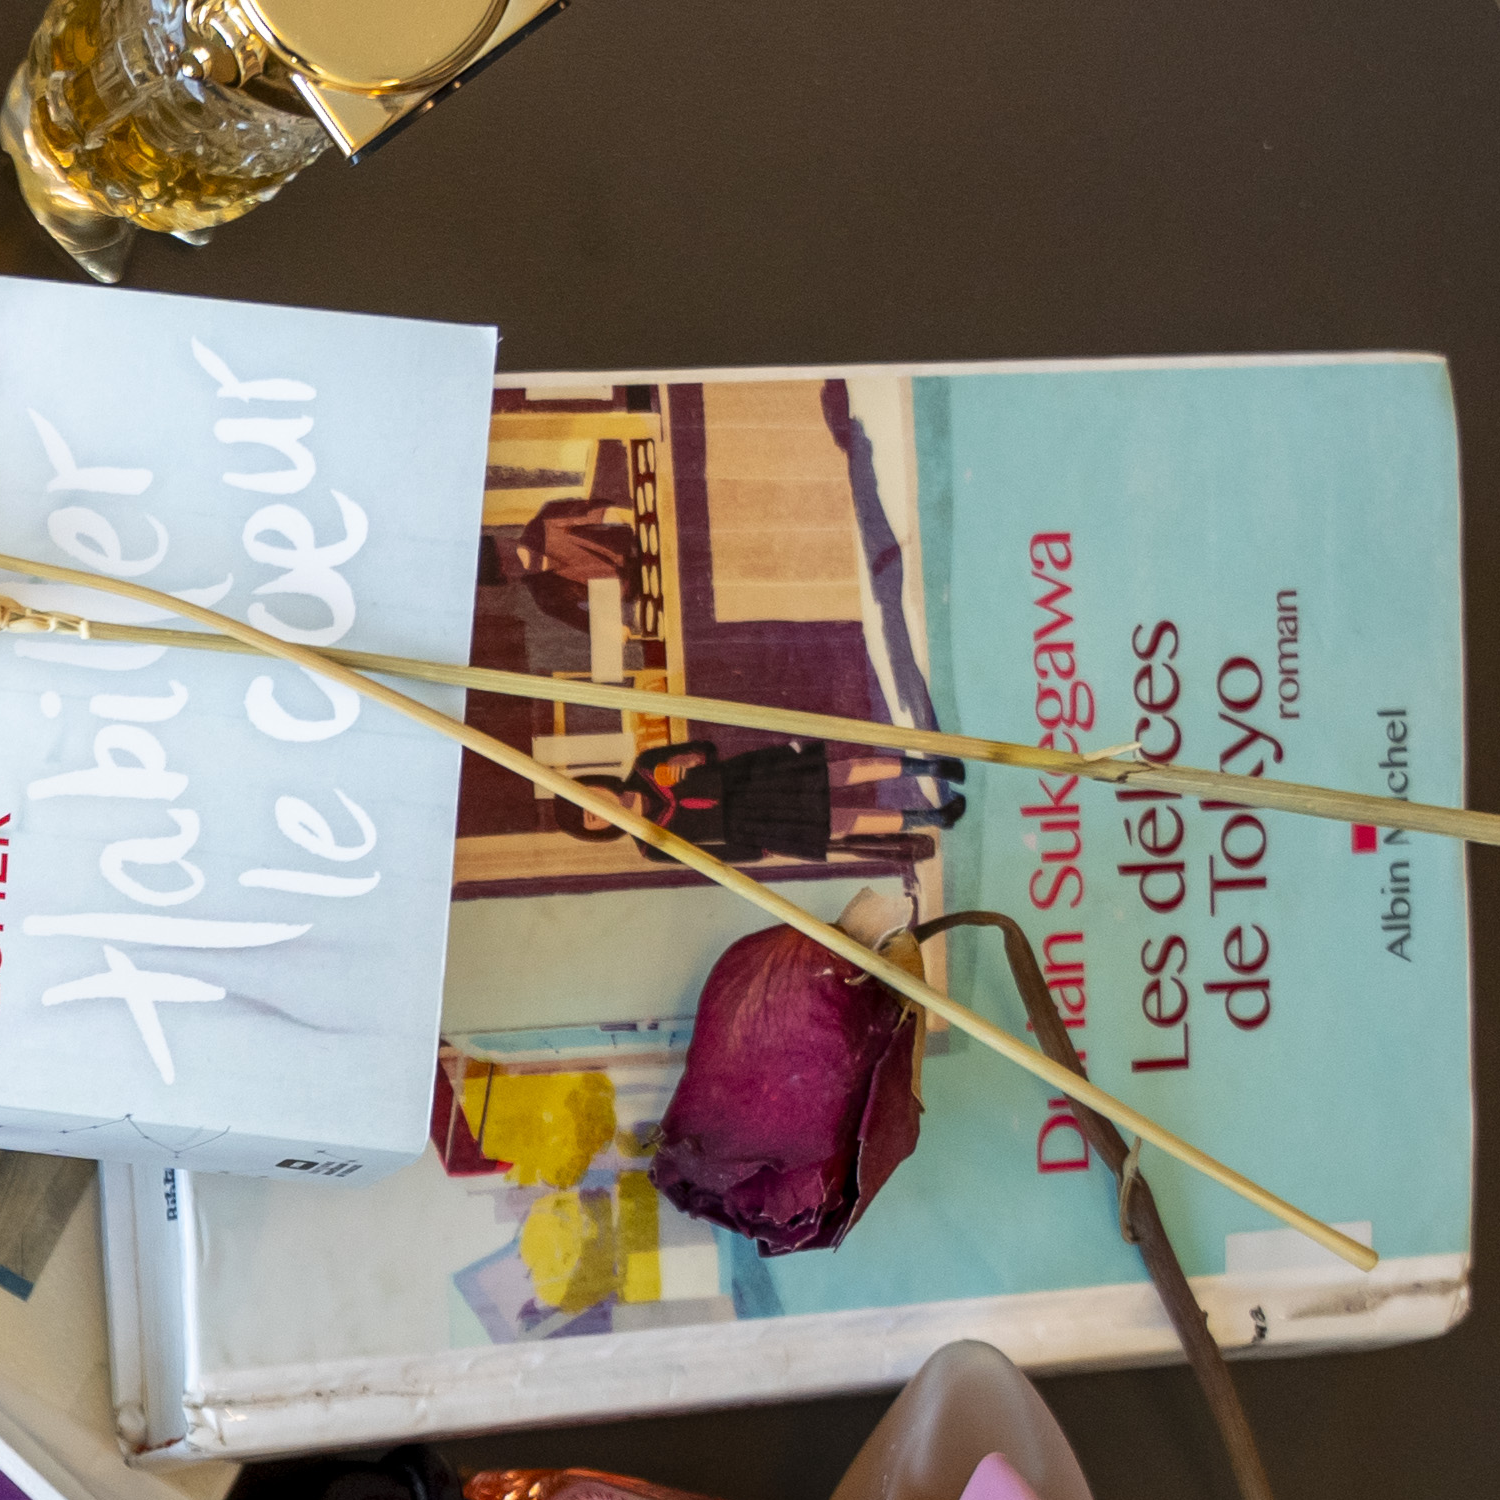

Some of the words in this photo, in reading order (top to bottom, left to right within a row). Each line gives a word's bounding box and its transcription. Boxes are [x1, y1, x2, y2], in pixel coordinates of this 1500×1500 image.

[1021, 530, 1095, 911] Sukegawa
[1276, 589, 1299, 720] roman
[1116, 618, 1185, 914] délces
[1199, 656, 1283, 917] Tokyo
[239, 787, 381, 897] le
[1204, 924, 1272, 1031] de
[1381, 860, 1412, 963] Albin
[1132, 935, 1190, 1073] Les
